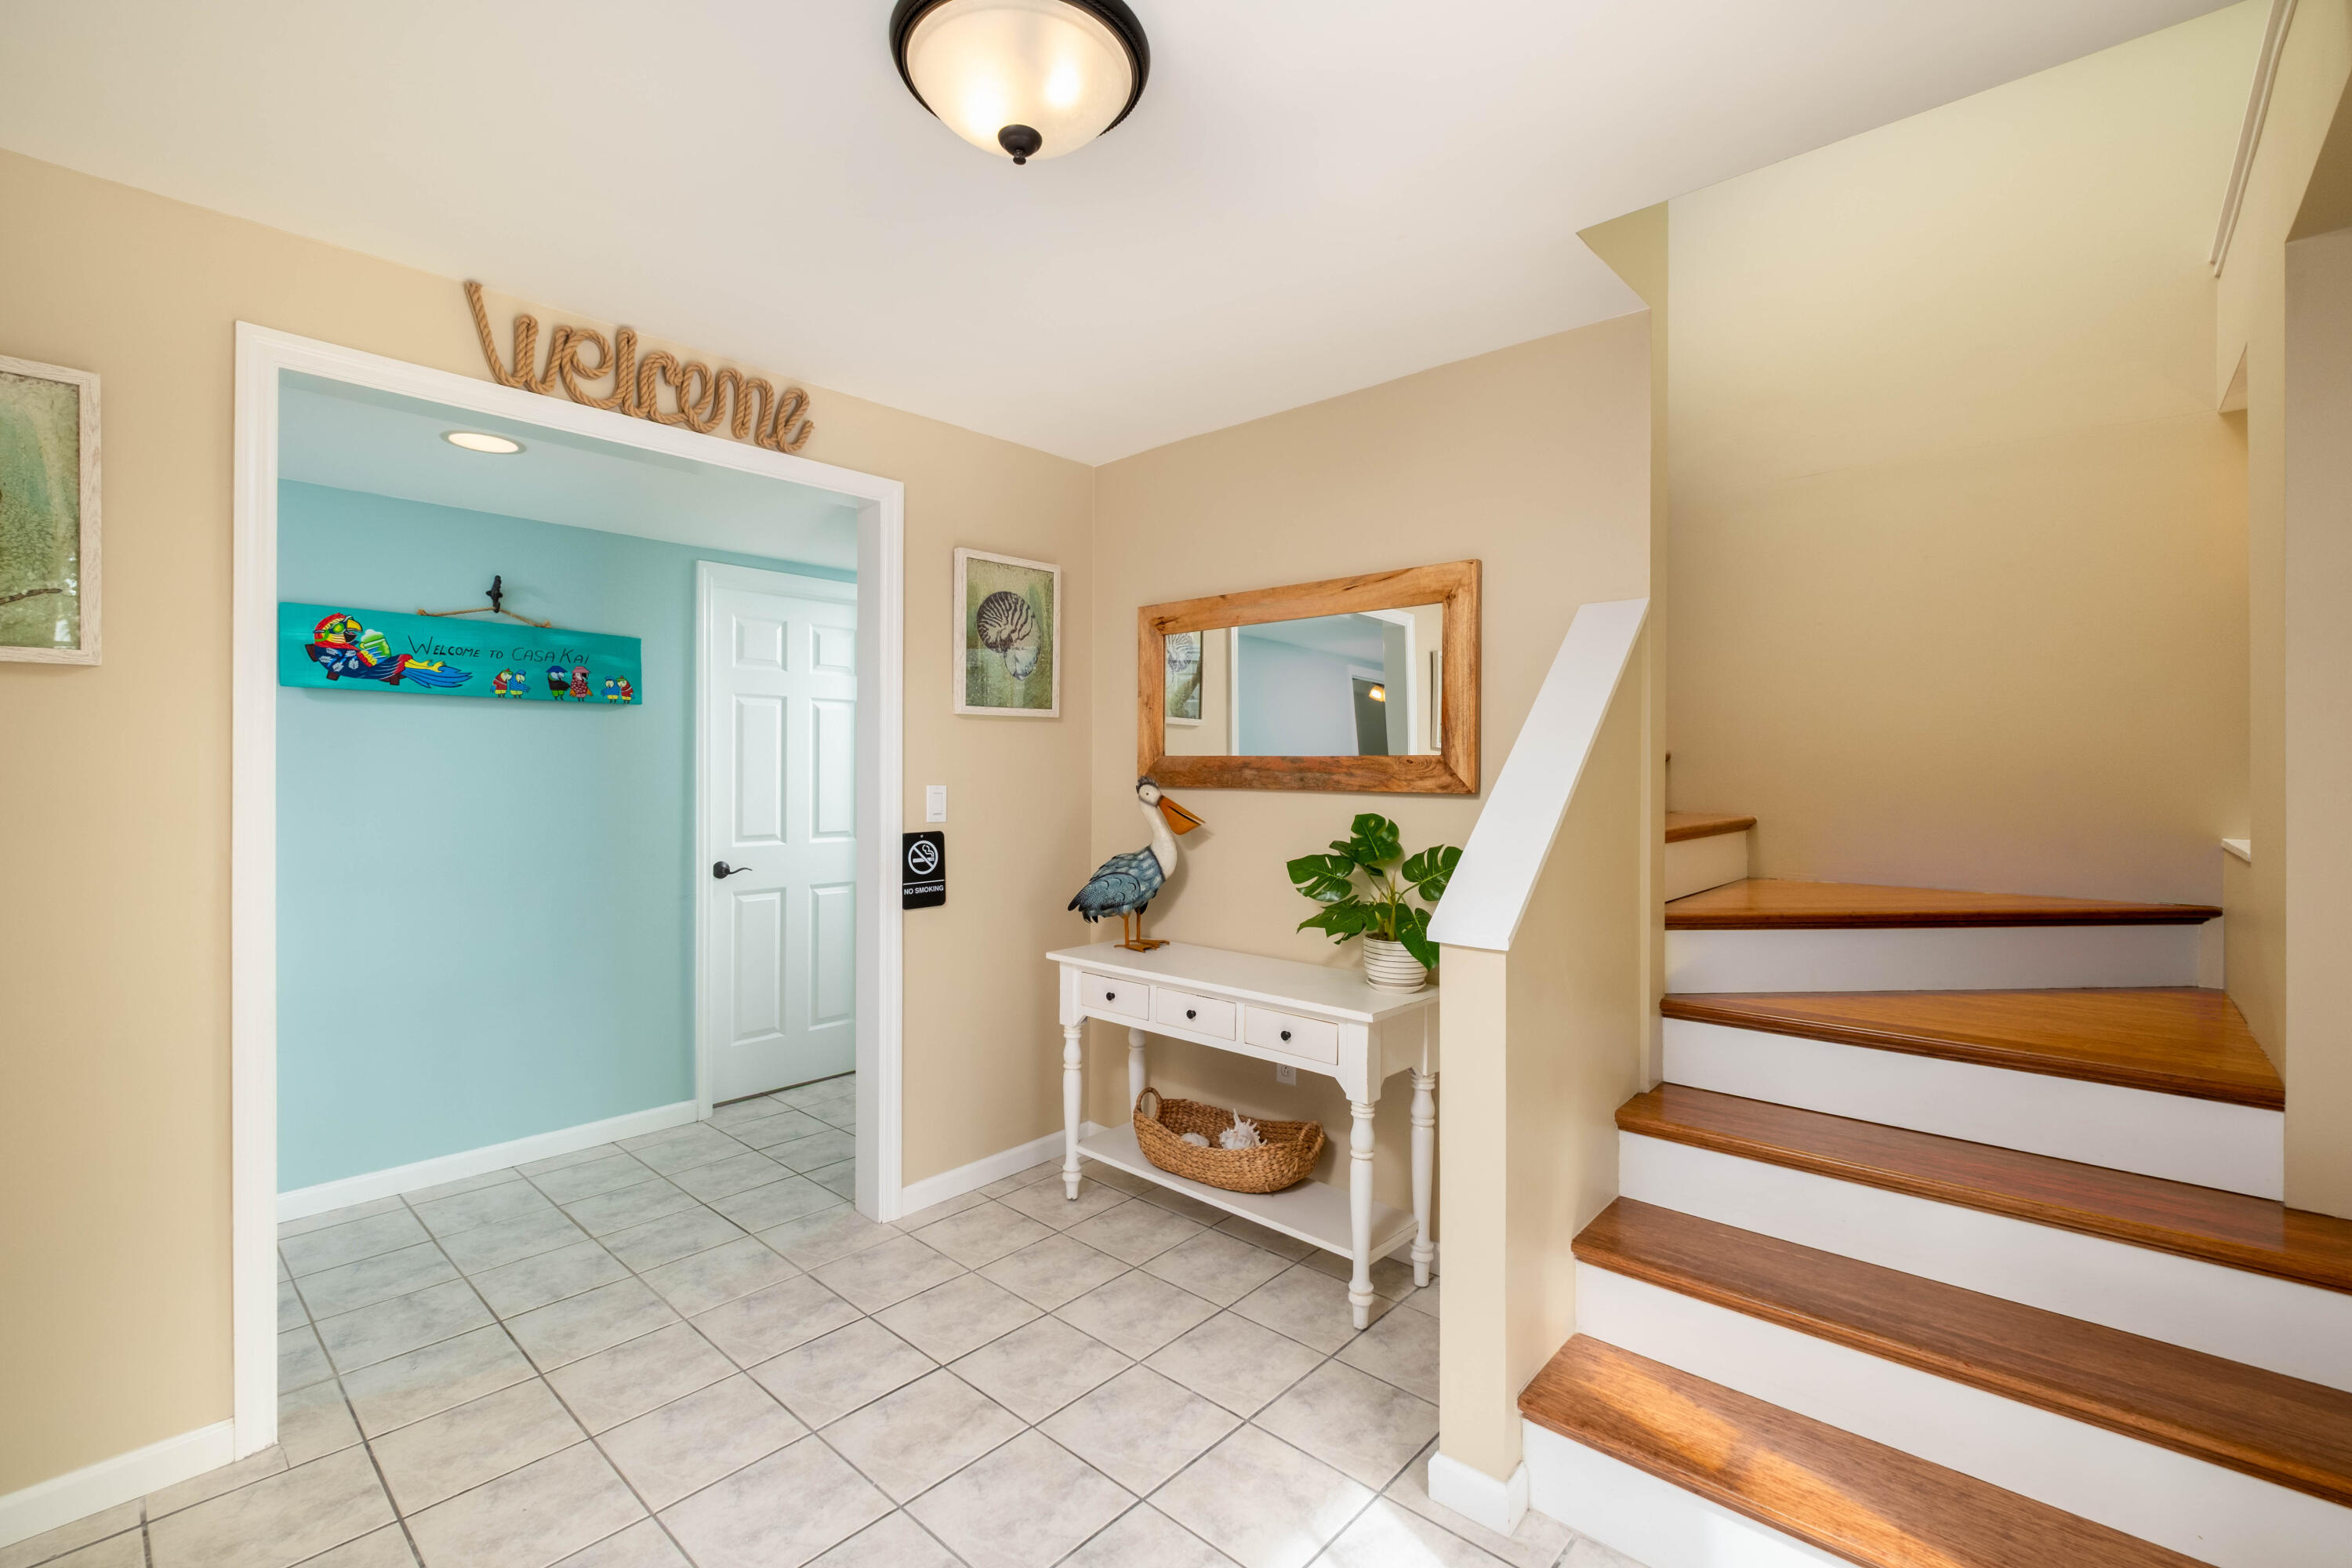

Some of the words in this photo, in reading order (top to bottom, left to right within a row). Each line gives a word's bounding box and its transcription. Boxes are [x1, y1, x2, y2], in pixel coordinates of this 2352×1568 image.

[408, 635, 481, 657] WELCOME
[489, 650, 503, 659] TO
[512, 647, 555, 662] CASA
[915, 885, 944, 894] SMOKING
